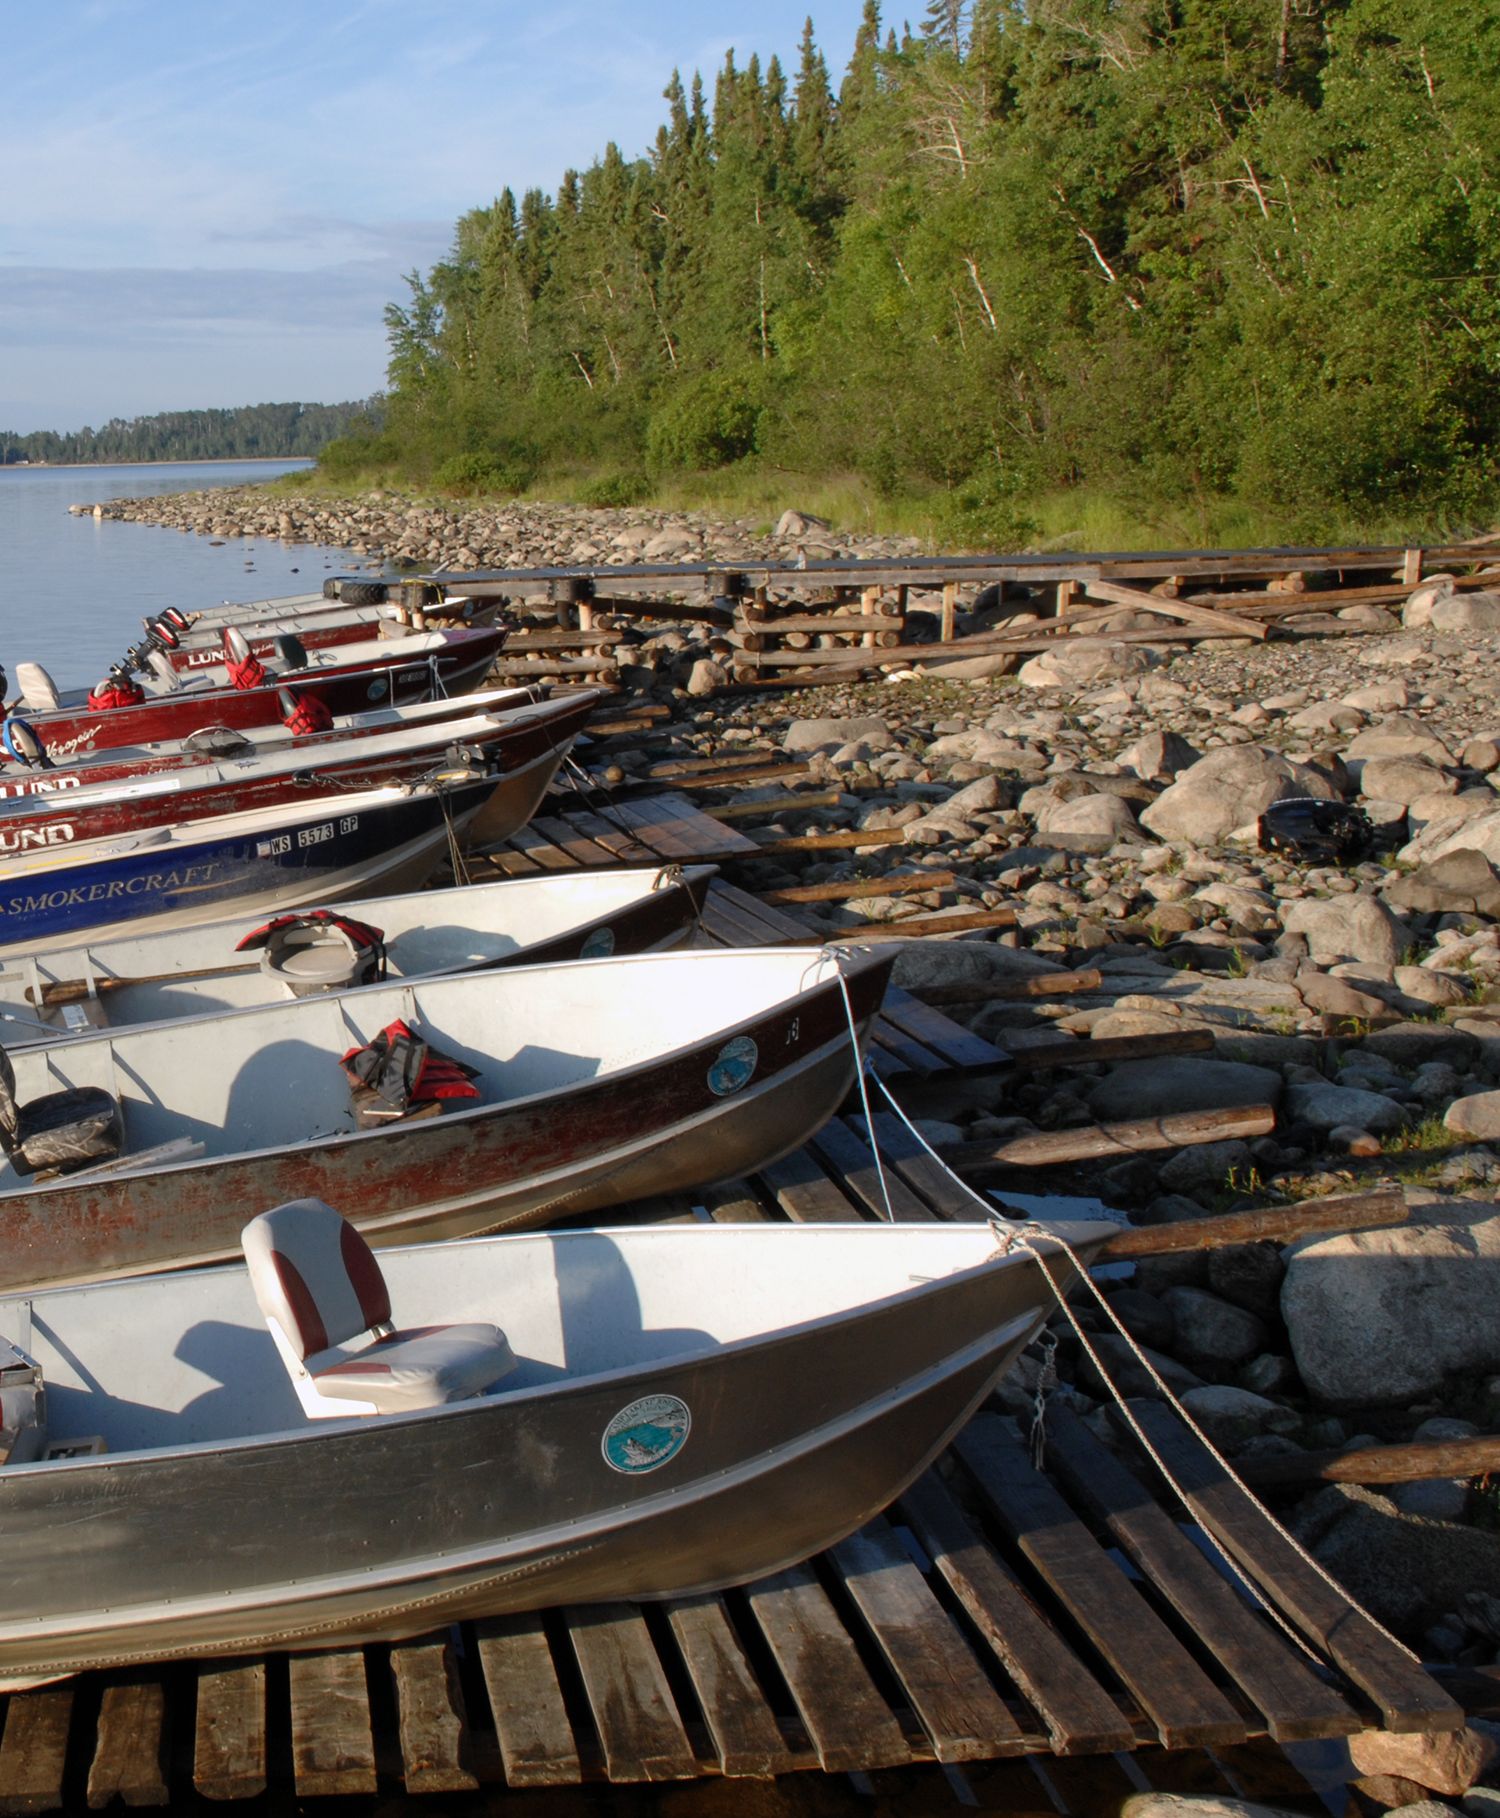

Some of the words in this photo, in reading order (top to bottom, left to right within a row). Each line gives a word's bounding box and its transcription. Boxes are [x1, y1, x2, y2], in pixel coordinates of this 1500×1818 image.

[271, 837, 289, 854] WS
[300, 825, 333, 847] 5573
[341, 817, 357, 833] GP
[8, 863, 220, 915] SMOKERCRAFT
